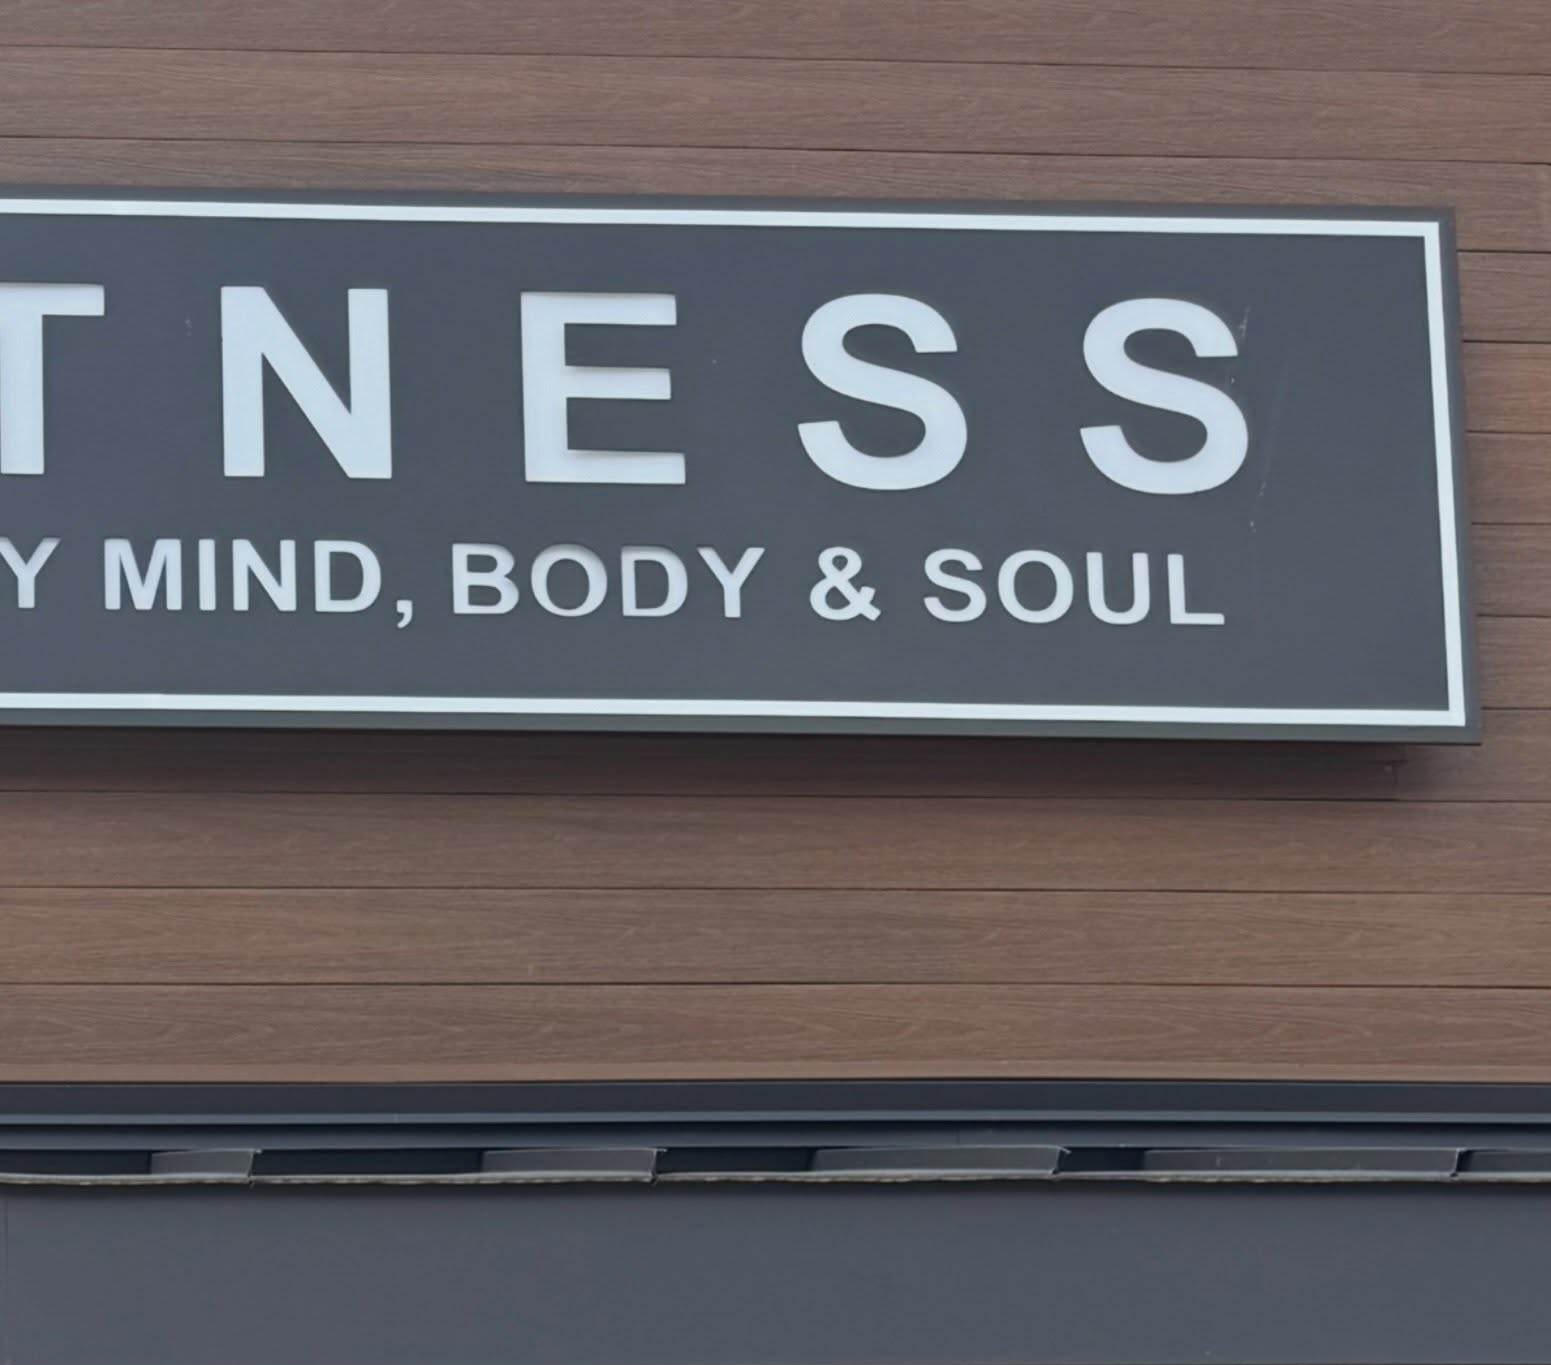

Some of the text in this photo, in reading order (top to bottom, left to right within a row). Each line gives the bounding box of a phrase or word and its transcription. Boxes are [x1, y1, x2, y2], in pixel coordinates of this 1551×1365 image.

[104, 539, 413, 628] MIND,
[452, 544, 765, 618] BODY
[810, 546, 881, 621] &
[924, 548, 1225, 625] SOUL
